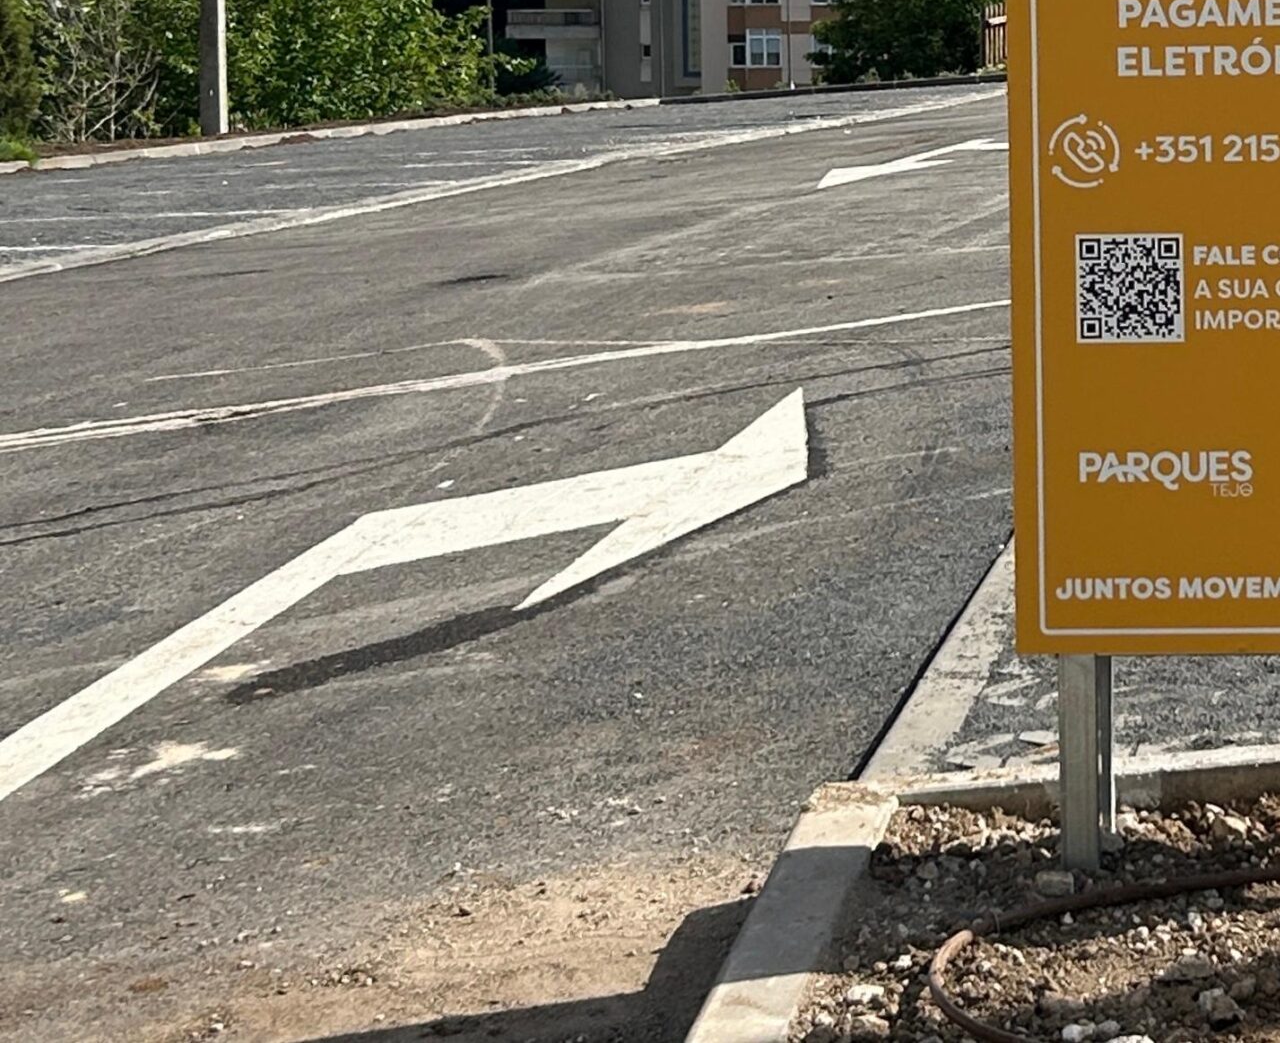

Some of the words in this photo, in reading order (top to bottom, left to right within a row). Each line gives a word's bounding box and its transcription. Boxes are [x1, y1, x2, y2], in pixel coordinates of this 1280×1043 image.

[1135, 136, 1211, 162] +351
[1224, 135, 1280, 161] 215
[1194, 246, 1255, 265] FALE
[1195, 280, 1211, 298] A
[1219, 279, 1268, 298] SUA
[1080, 451, 1252, 490] PARQUES
[1211, 482, 1253, 497] TEJO
[1056, 578, 1171, 599] JUNTOS
